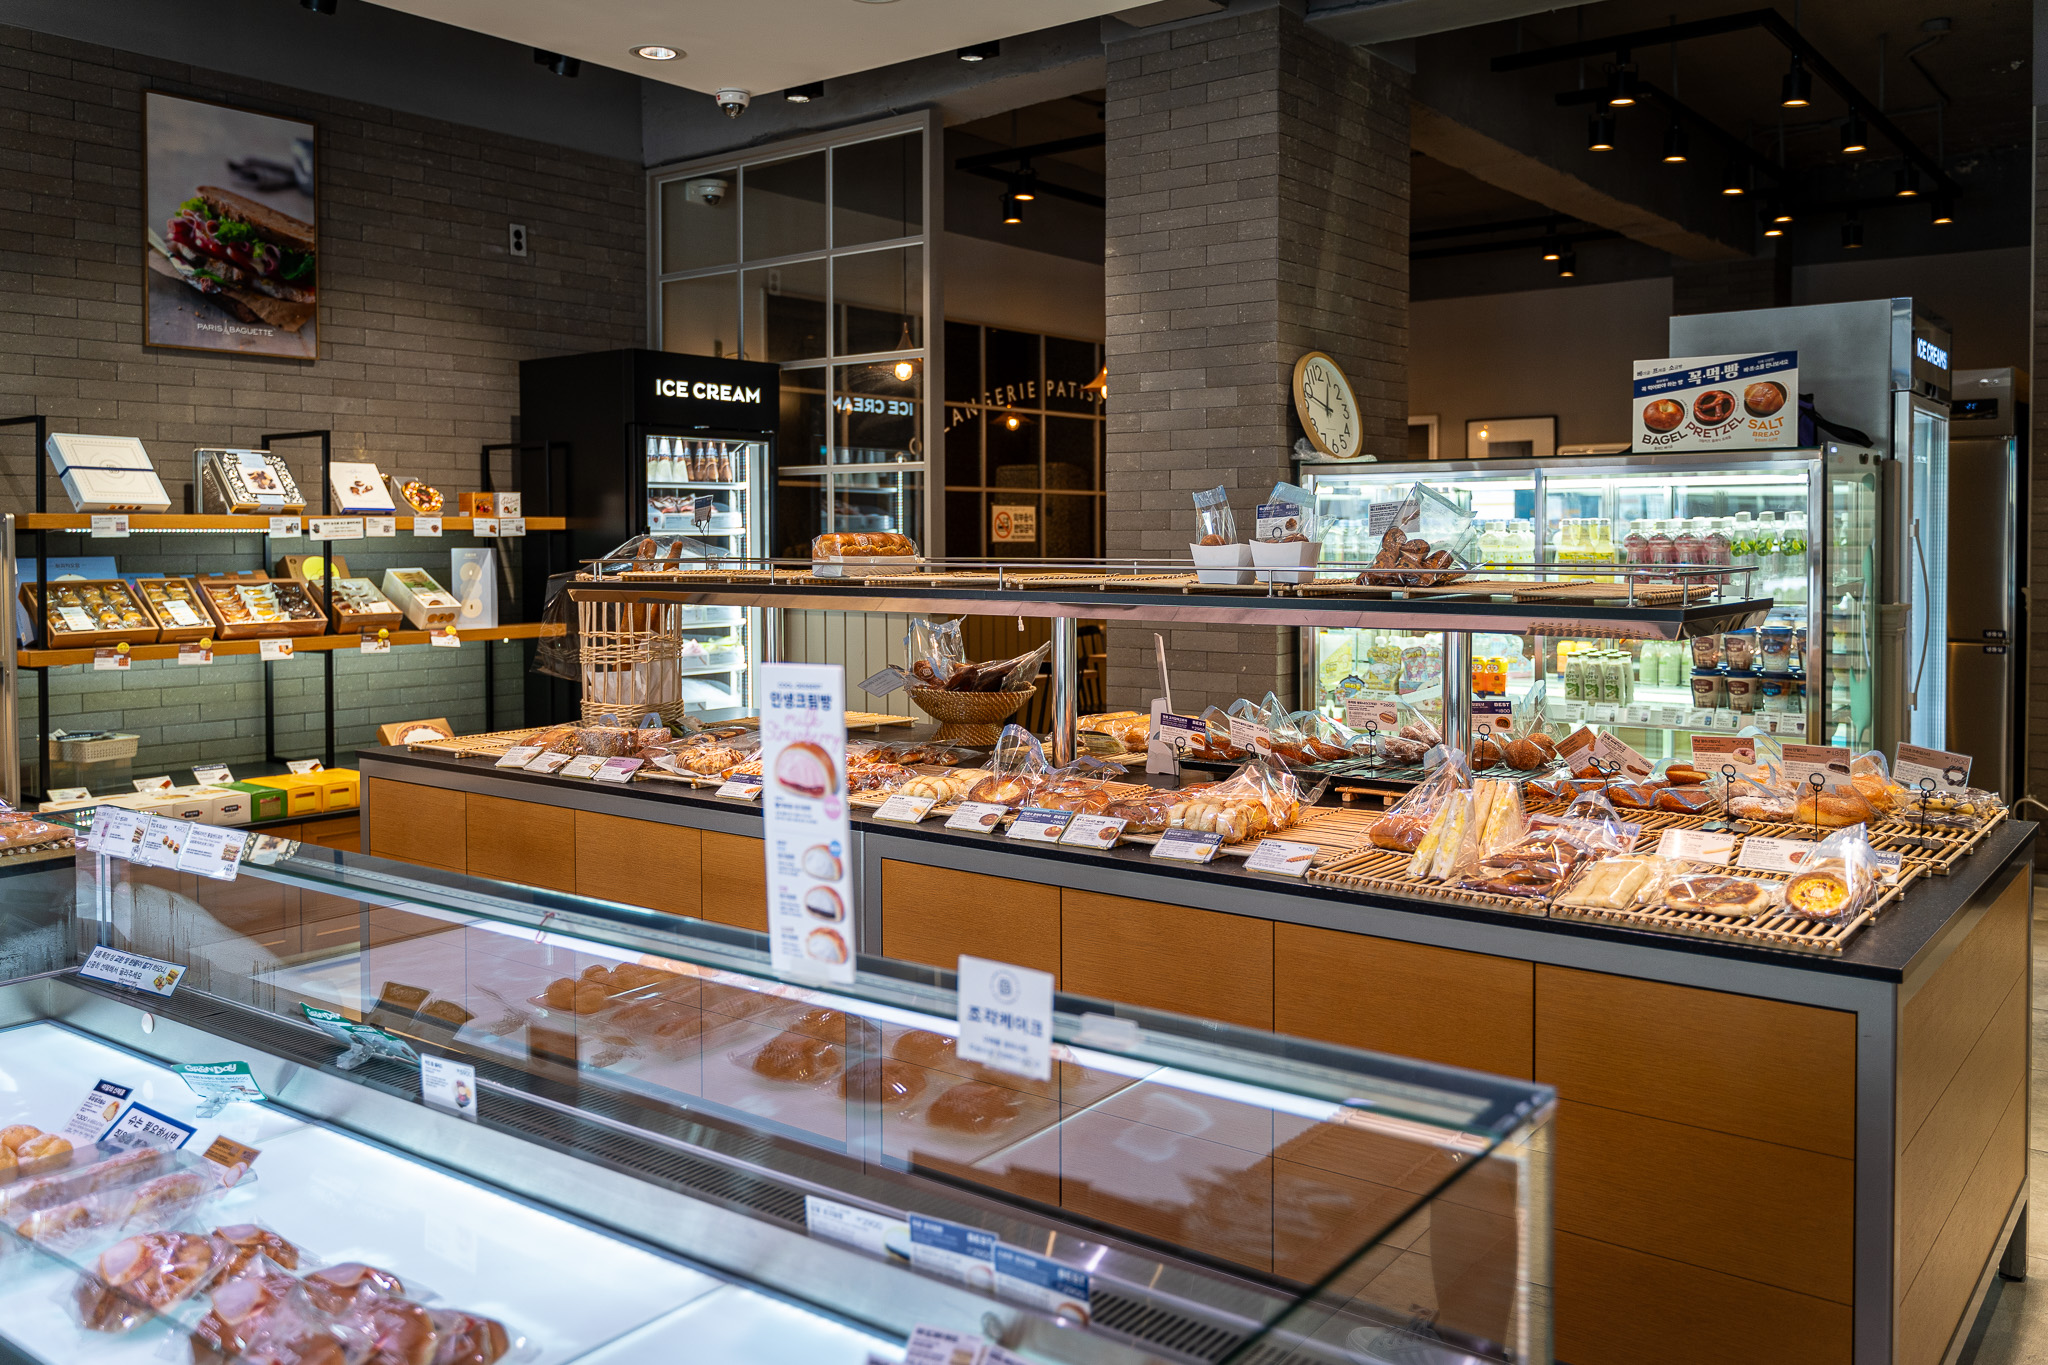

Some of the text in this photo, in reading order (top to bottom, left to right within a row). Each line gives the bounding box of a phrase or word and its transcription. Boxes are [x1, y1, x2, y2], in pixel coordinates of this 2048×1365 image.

[197, 323, 274, 337] PARIS BAGUETTE
[1917, 337, 1928, 360] ICE
[656, 379, 761, 404] ICE CREAM
[1333, 383, 1343, 401] 2
[1341, 403, 1350, 420] 3
[1343, 422, 1351, 438] 4
[1685, 417, 1745, 439] PRETZEL
[1748, 416, 1784, 430] SALT
[1339, 434, 1348, 450] 5
[1642, 431, 1688, 446] BAGEL
[1752, 430, 1780, 438] BREAD
[1331, 438, 1340, 454] 6
[770, 692, 832, 711] 인생크림빵
[226, 834, 245, 844] ₩6400
[119, 967, 143, 980] 골라주세요
[968, 1004, 1044, 1038] 조각케이크
[128, 1115, 144, 1128] 슈는
[143, 1121, 179, 1144] 필요하시면
[966, 1231, 994, 1245] BEST
[1057, 1267, 1085, 1282] BEST
